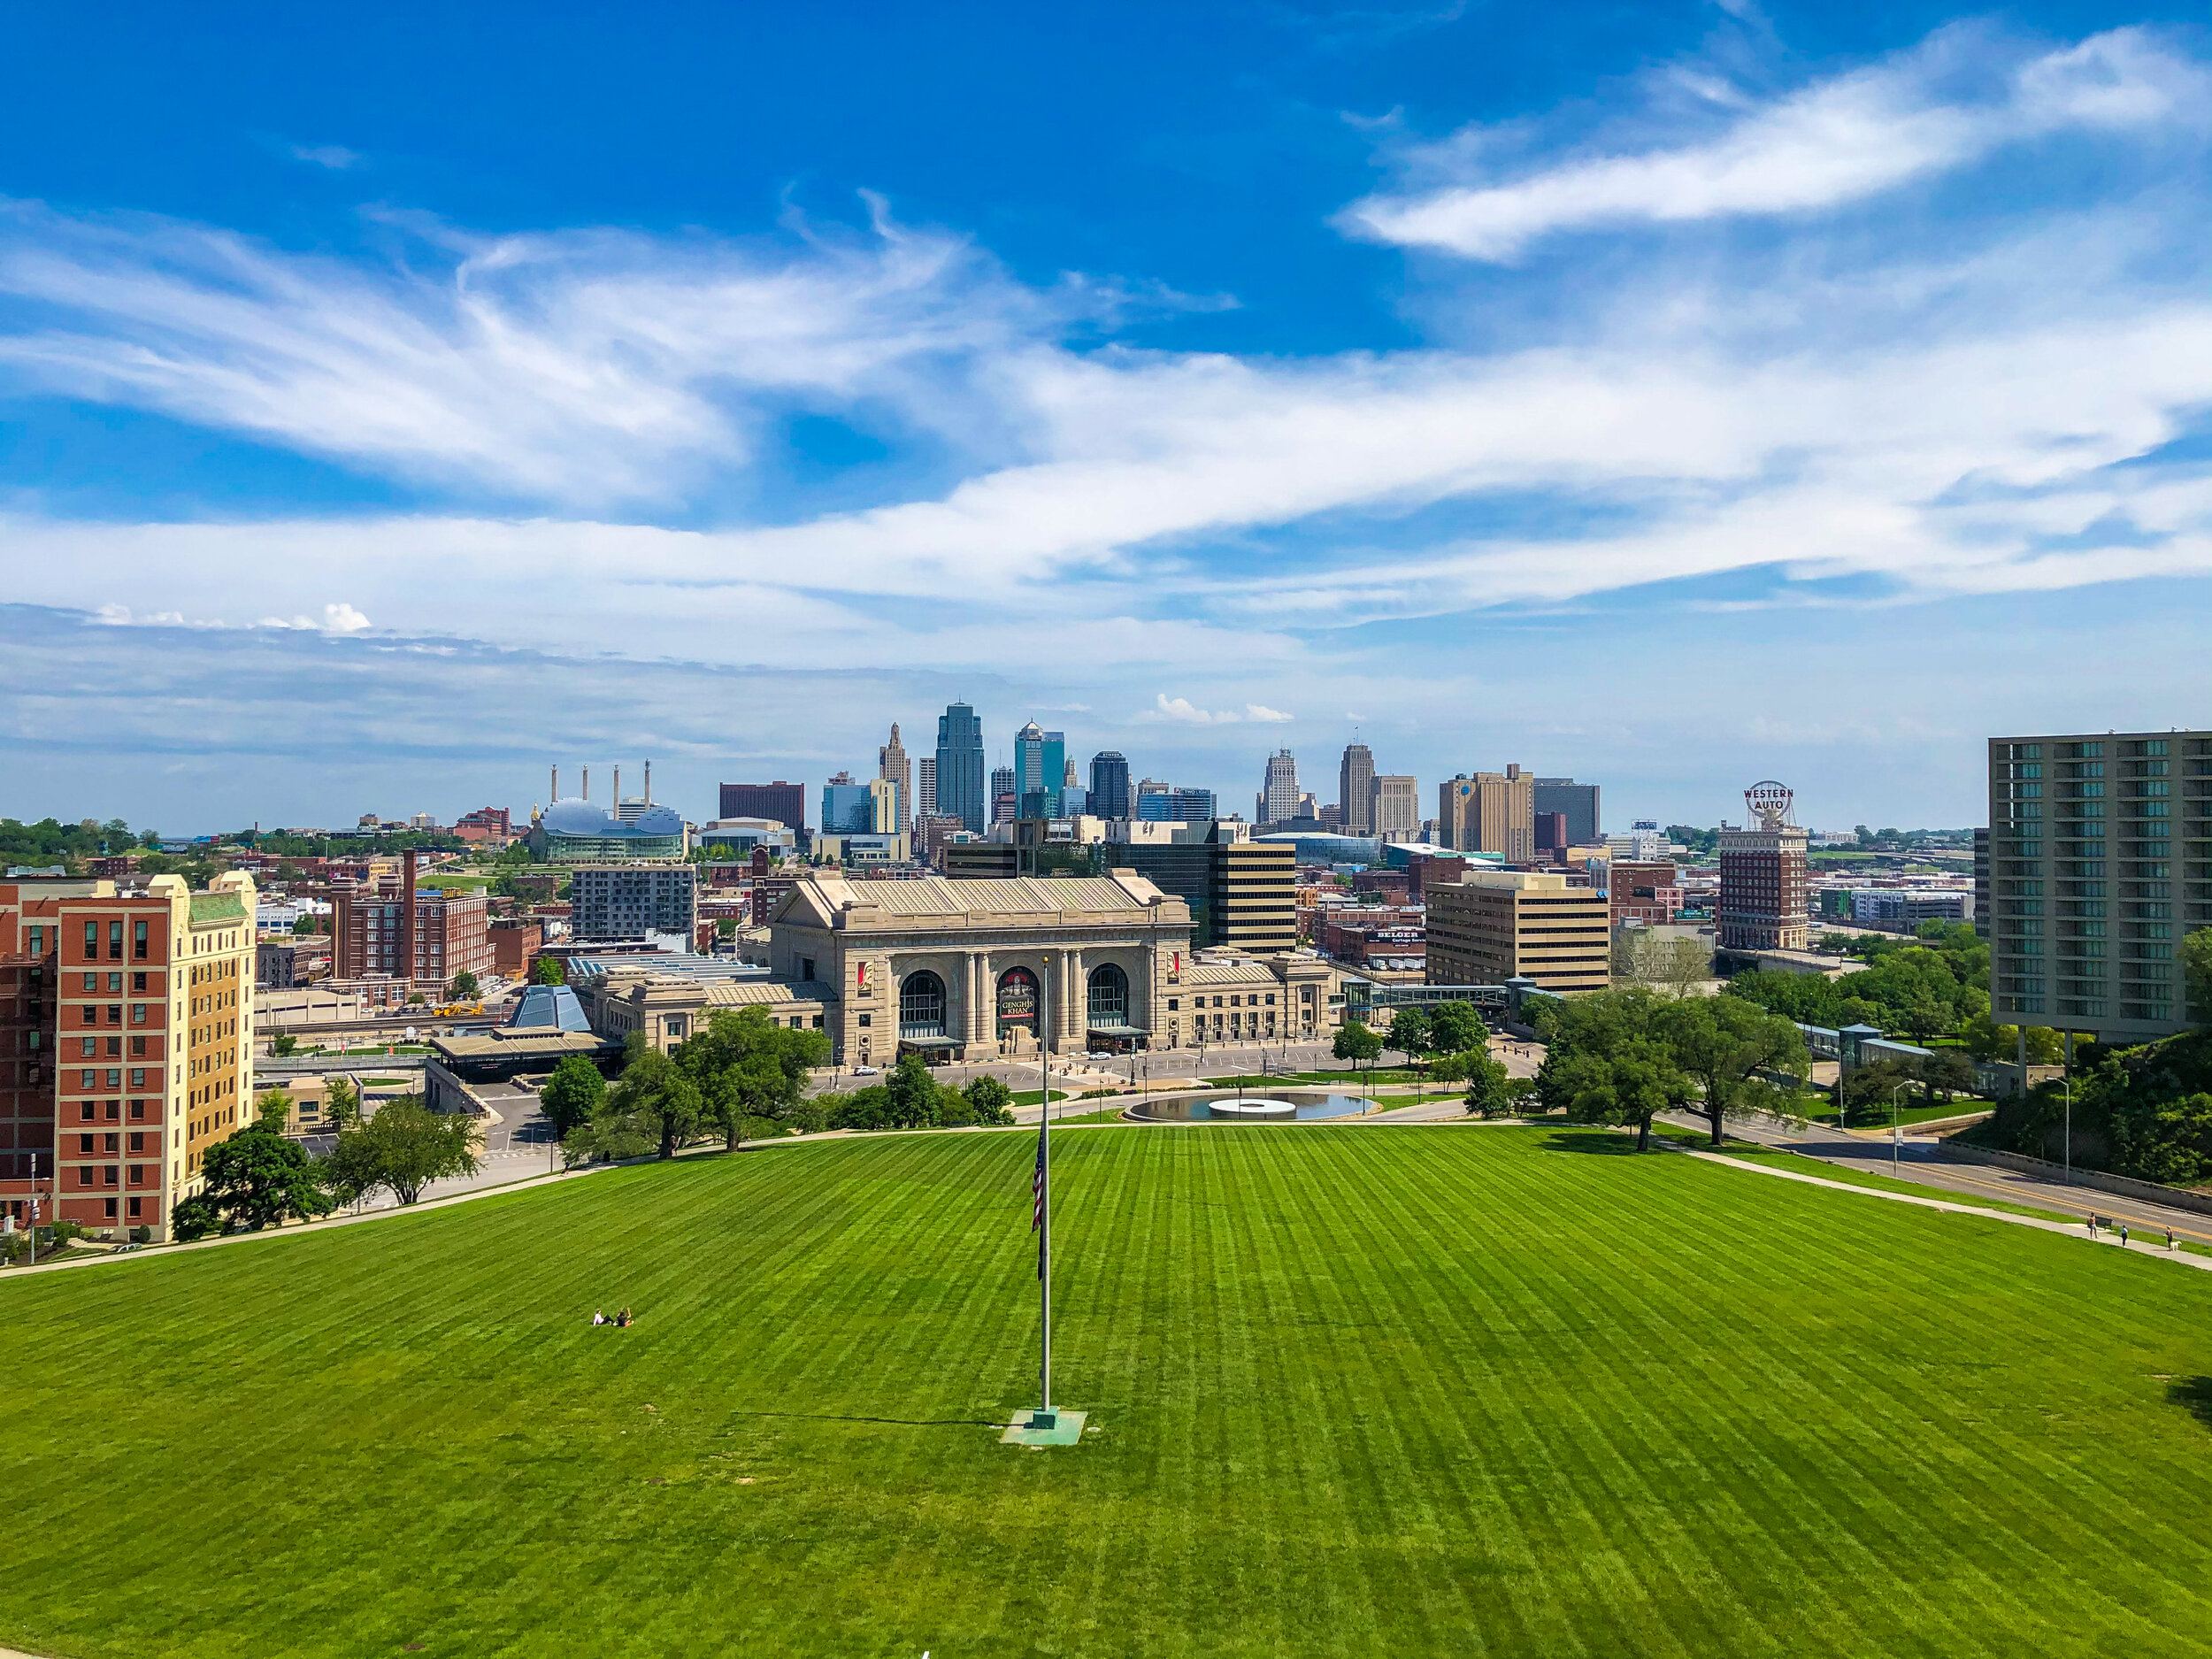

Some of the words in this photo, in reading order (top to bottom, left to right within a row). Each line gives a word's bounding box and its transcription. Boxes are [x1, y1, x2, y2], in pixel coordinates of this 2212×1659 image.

[1743, 788, 1793, 798] WESTERN
[1755, 800, 1784, 810] AUTO
[1002, 998, 1033, 1009] GENGHIS
